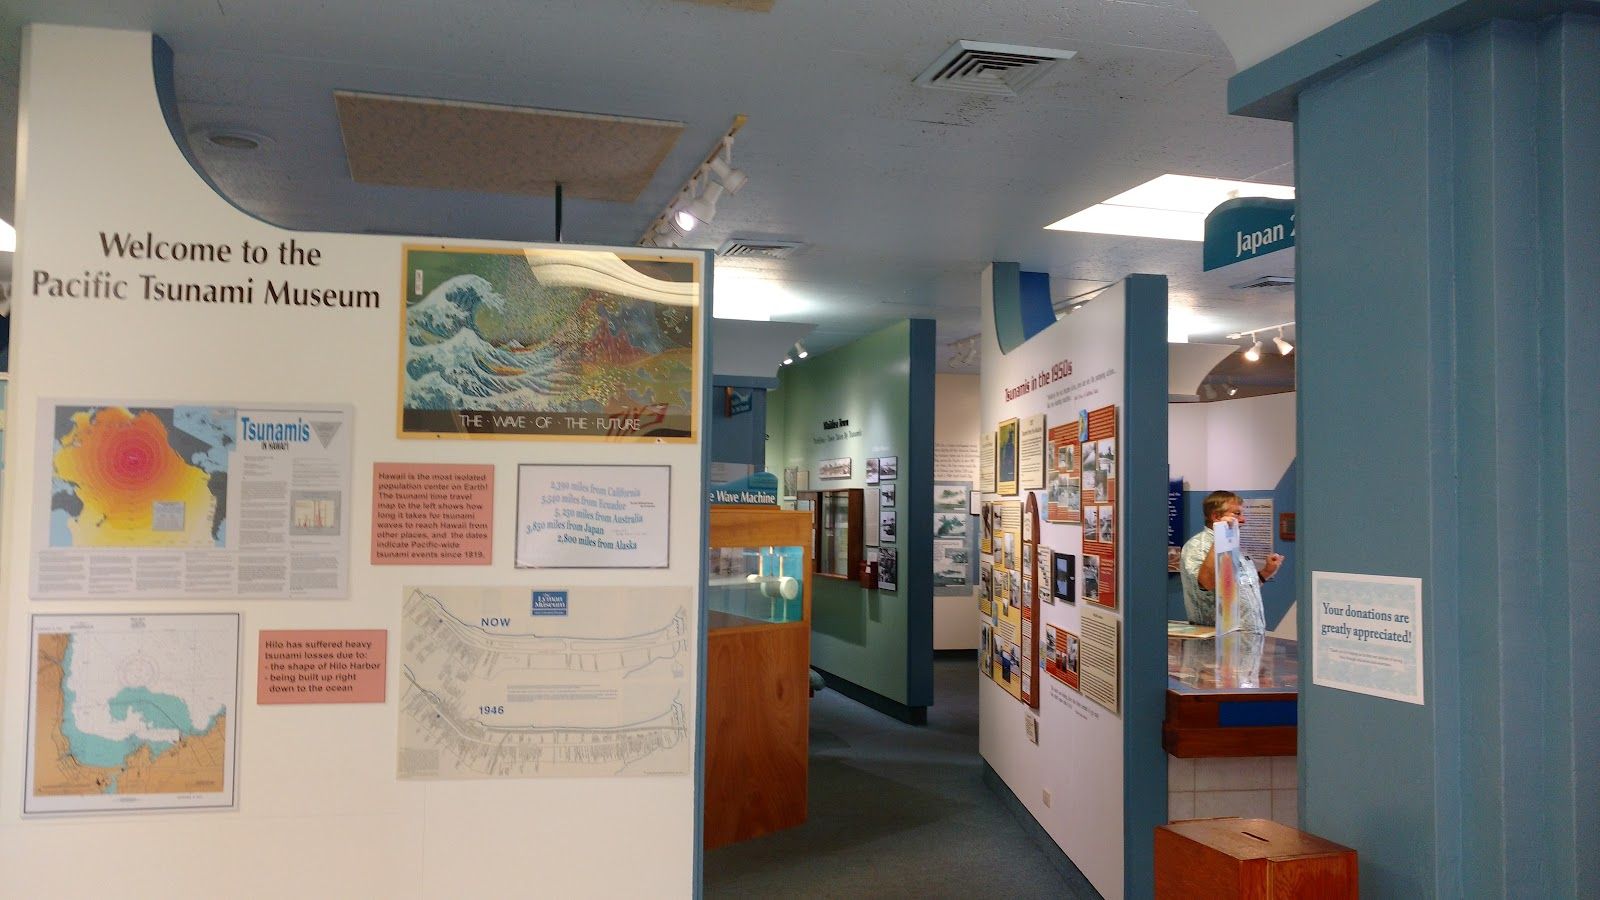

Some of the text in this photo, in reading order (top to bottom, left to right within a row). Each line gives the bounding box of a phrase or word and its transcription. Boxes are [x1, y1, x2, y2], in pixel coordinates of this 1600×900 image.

[1236, 224, 1284, 257] Japan
[99, 231, 321, 266] Welcome to the
[32, 270, 380, 308] Pacific Tsunami Museum
[1005, 379, 1030, 402] Tsunamis
[1031, 376, 1037, 391] in
[1039, 371, 1050, 388] the
[1051, 360, 1072, 382] 1950s
[241, 416, 310, 441] Tsunamis
[459, 414, 641, 431] THE WAVE OF THE FUTURE
[378, 483, 422, 491] population
[571, 481, 589, 492] miles
[590, 484, 606, 495] from
[608, 486, 640, 498] California
[561, 494, 580, 504] miles
[581, 496, 597, 507] from
[716, 490, 739, 502] Wave
[740, 491, 776, 503] Machine
[377, 512, 396, 520] long
[576, 510, 593, 520] miles
[595, 512, 611, 522] from
[613, 513, 643, 524] Australia
[547, 520, 565, 529] miles
[566, 520, 582, 531] from
[584, 523, 604, 535] Japan
[578, 535, 596, 546] miles
[598, 538, 613, 549] from
[615, 540, 637, 550] Alaska
[1323, 602, 1409, 623] Your donations are
[481, 617, 511, 627] NOW
[1321, 623, 1412, 643] greatly appreciated!
[265, 640, 283, 649] Hilo
[305, 641, 342, 649] suffered
[345, 640, 372, 649] heavy
[265, 652, 302, 660] tsunami
[270, 662, 285, 670] the
[287, 663, 315, 671] shape
[318, 662, 327, 670] of
[329, 662, 347, 670] Hilo
[350, 662, 380, 670] Harbor
[270, 673, 296, 682] being
[298, 673, 319, 681] built
[335, 673, 357, 682] right
[308, 684, 323, 692] the
[479, 705, 504, 715] 1946
